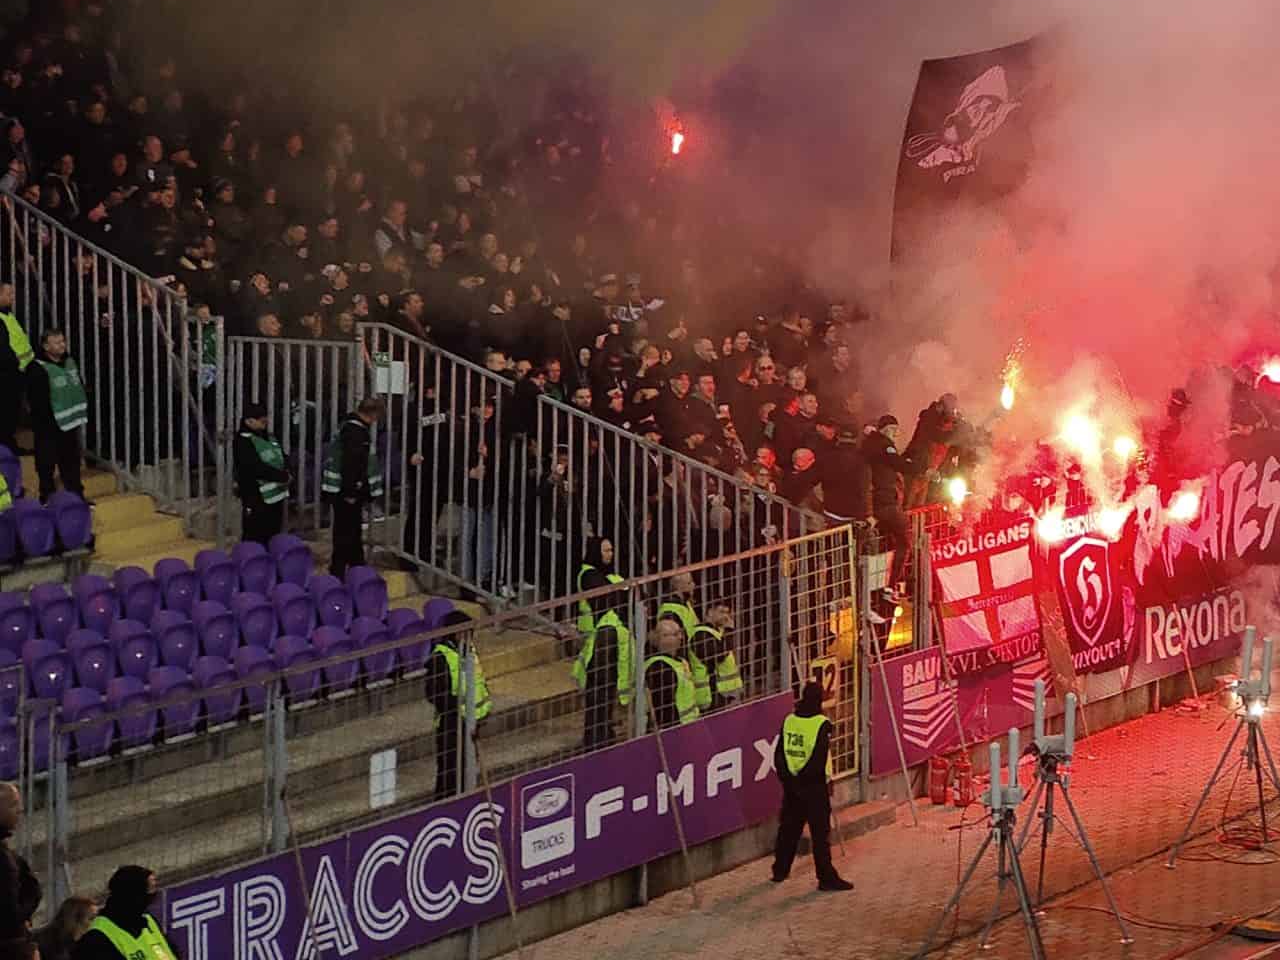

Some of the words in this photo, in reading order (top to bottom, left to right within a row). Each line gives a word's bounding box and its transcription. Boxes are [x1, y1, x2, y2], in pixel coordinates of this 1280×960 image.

[931, 522, 1031, 562] HOOLIGANS
[1146, 590, 1247, 664] Rexona
[586, 735, 780, 840] F-MAX
[172, 803, 504, 960] TRACCS
